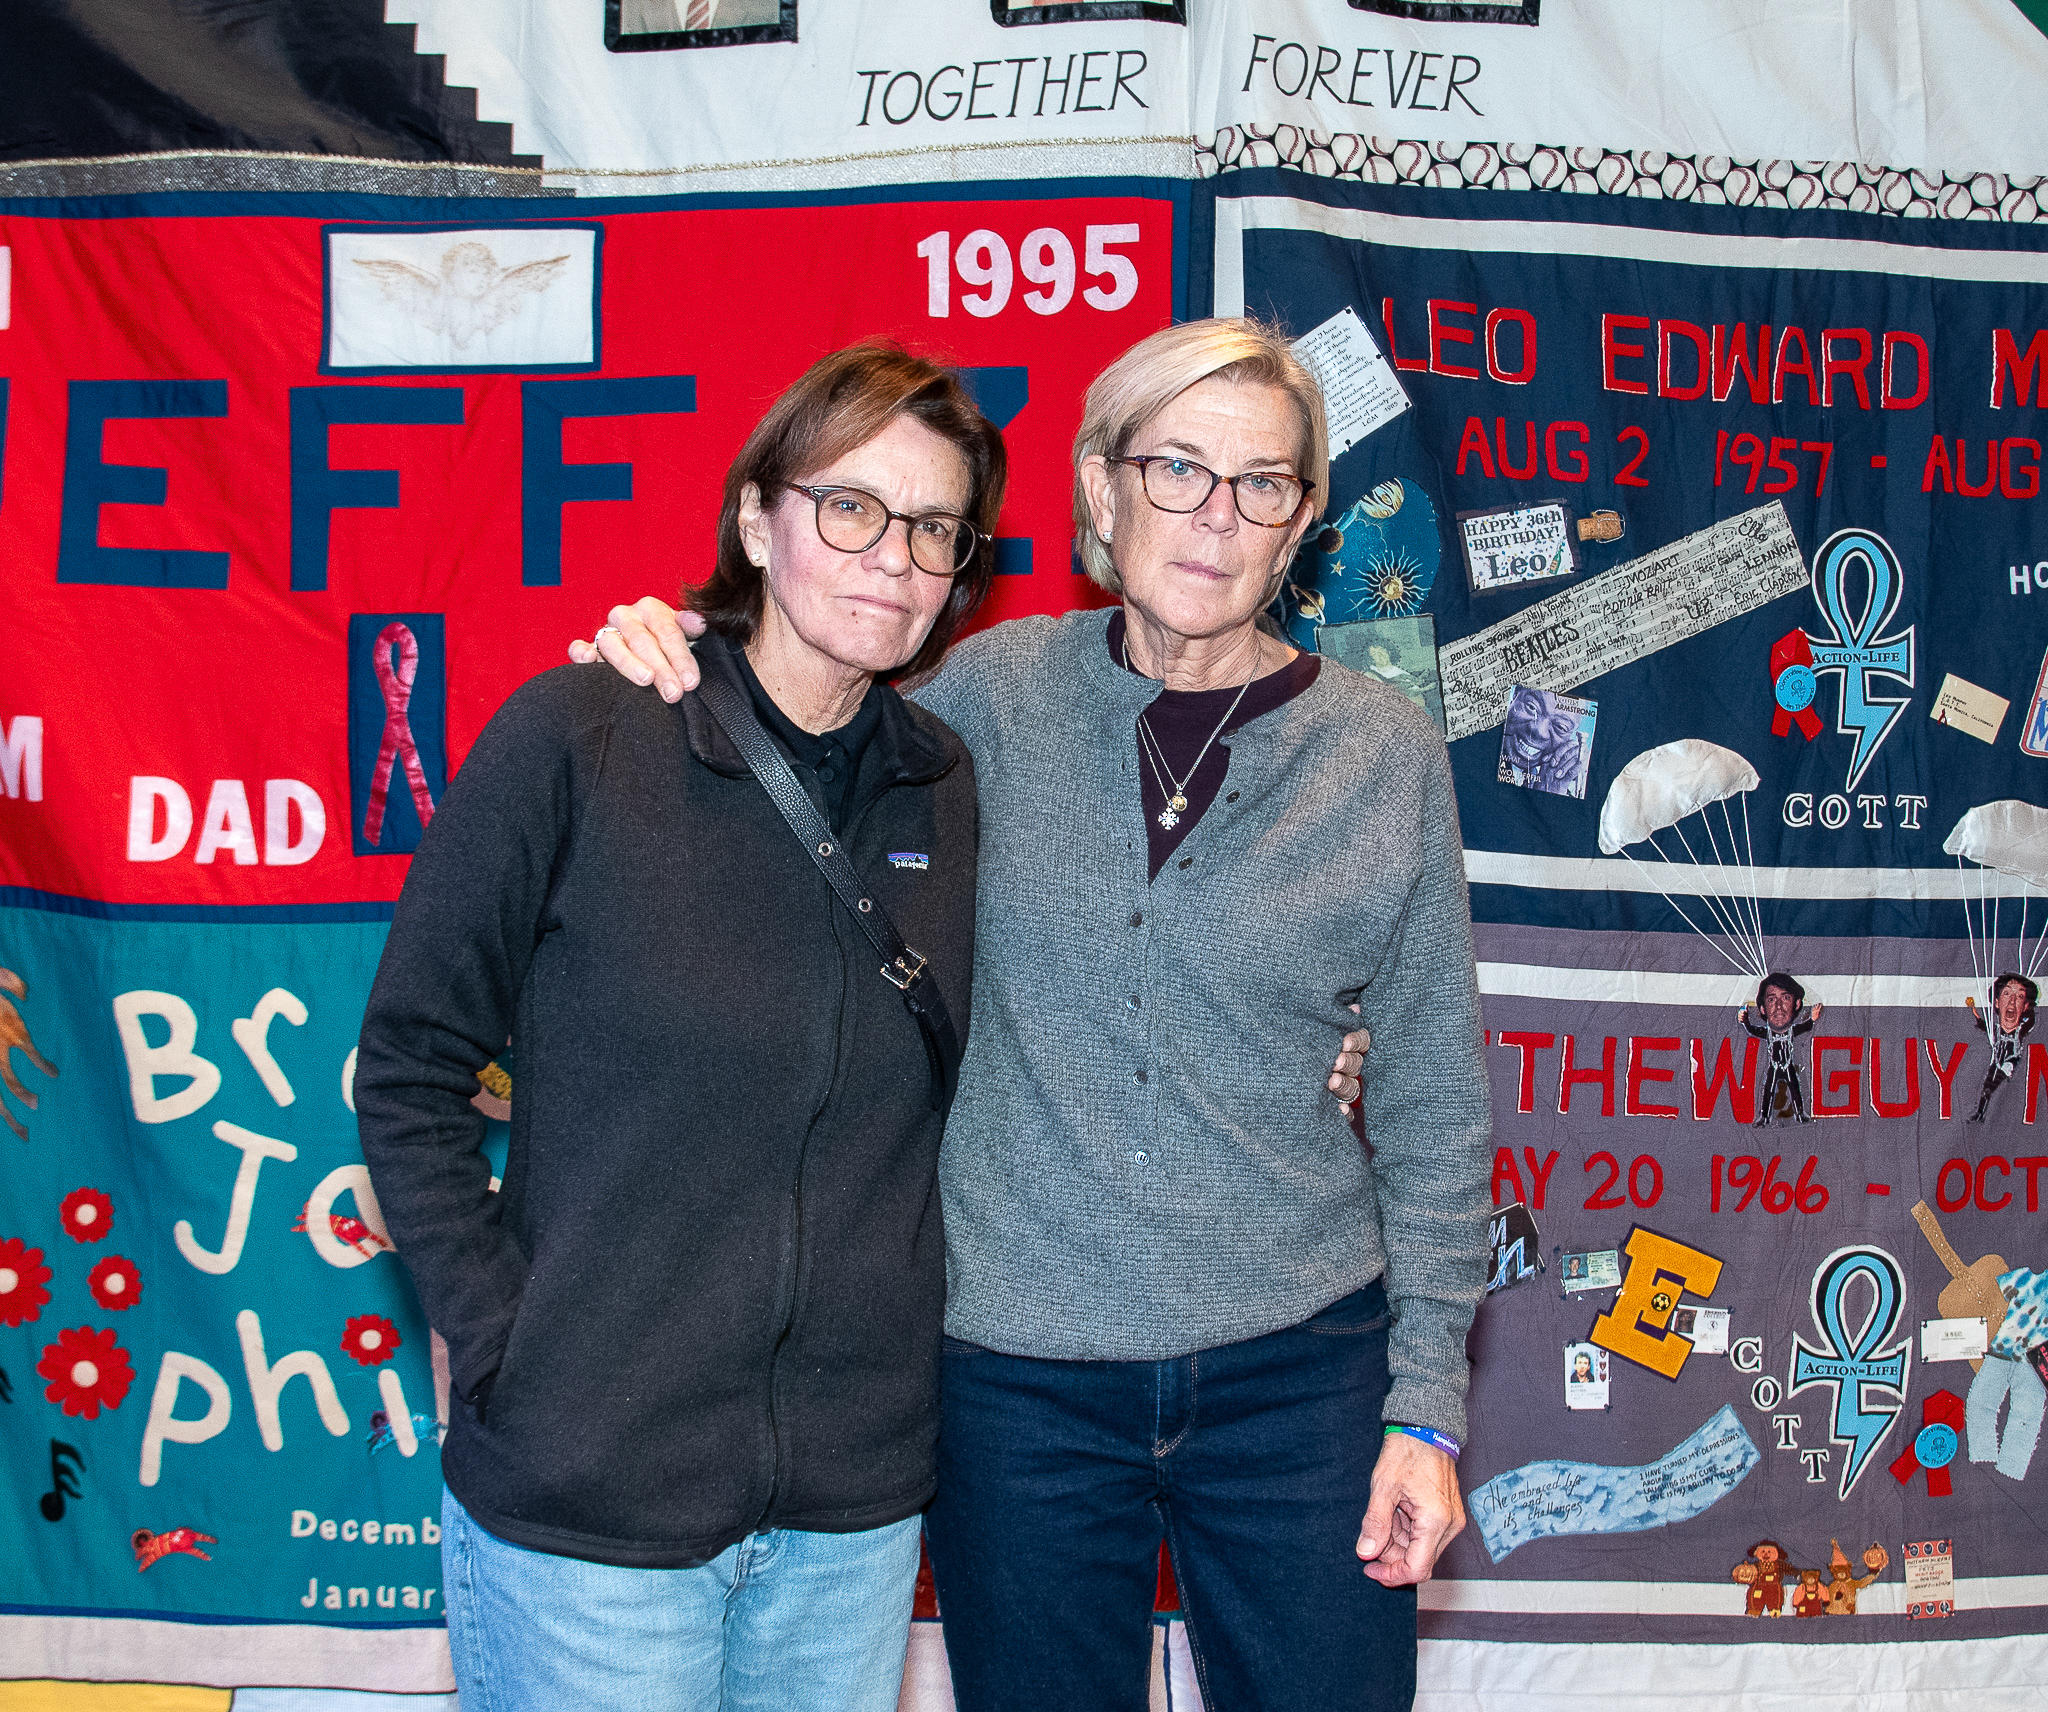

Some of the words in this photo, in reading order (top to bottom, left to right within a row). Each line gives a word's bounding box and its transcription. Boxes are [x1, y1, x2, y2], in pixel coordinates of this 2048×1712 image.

[856, 50, 1150, 127] TOGETHER
[1242, 34, 1484, 117] FOREVER
[917, 223, 1140, 318] 1995
[1382, 297, 1537, 385] LEO
[1602, 312, 1930, 410] EDWARD
[1456, 417, 1591, 483] AUG
[1615, 426, 1650, 487] 2
[1715, 430, 1835, 497] 1957
[1921, 434, 2042, 499] AUG
[0, 375, 696, 590] EFF
[1466, 516, 1521, 536] HAPPY
[1527, 510, 1563, 527] 36th
[1473, 526, 1559, 551] BIRTHDAY!
[1485, 553, 1547, 580] Leo
[1624, 553, 1681, 588] MOZART
[1744, 540, 1798, 570] LENNON
[1686, 598, 1715, 621] U2
[1450, 641, 1485, 666] ROLLING
[1502, 617, 1580, 674] BEATLES
[1555, 703, 1596, 718] ARMSTRONG
[1500, 761, 1506, 769] A
[1501, 754, 1521, 764] WHAT
[126, 776, 327, 866] DAD
[1783, 792, 1928, 829] COTT
[112, 987, 358, 1124] Br
[1484, 1030, 1760, 1123] THEW
[1810, 1036, 1968, 1121] GUY
[1491, 1146, 1560, 1210] AY
[1584, 1151, 1664, 1210] 20
[1710, 1154, 1830, 1214] 1966
[1936, 1156, 2048, 1213] OCT
[139, 1309, 450, 1486] phi
[1644, 1466, 1661, 1479] HAVE
[1688, 1450, 1700, 1460] MY
[1686, 1472, 1697, 1482] MY
[1483, 1482, 1507, 1513] He
[1510, 1473, 1560, 1504] embraced
[1522, 1493, 1544, 1509] and
[1646, 1490, 1665, 1504] LOVE
[291, 1509, 441, 1545] Decemb
[1528, 1500, 1582, 1523] challenges
[301, 1577, 446, 1616] Januar
